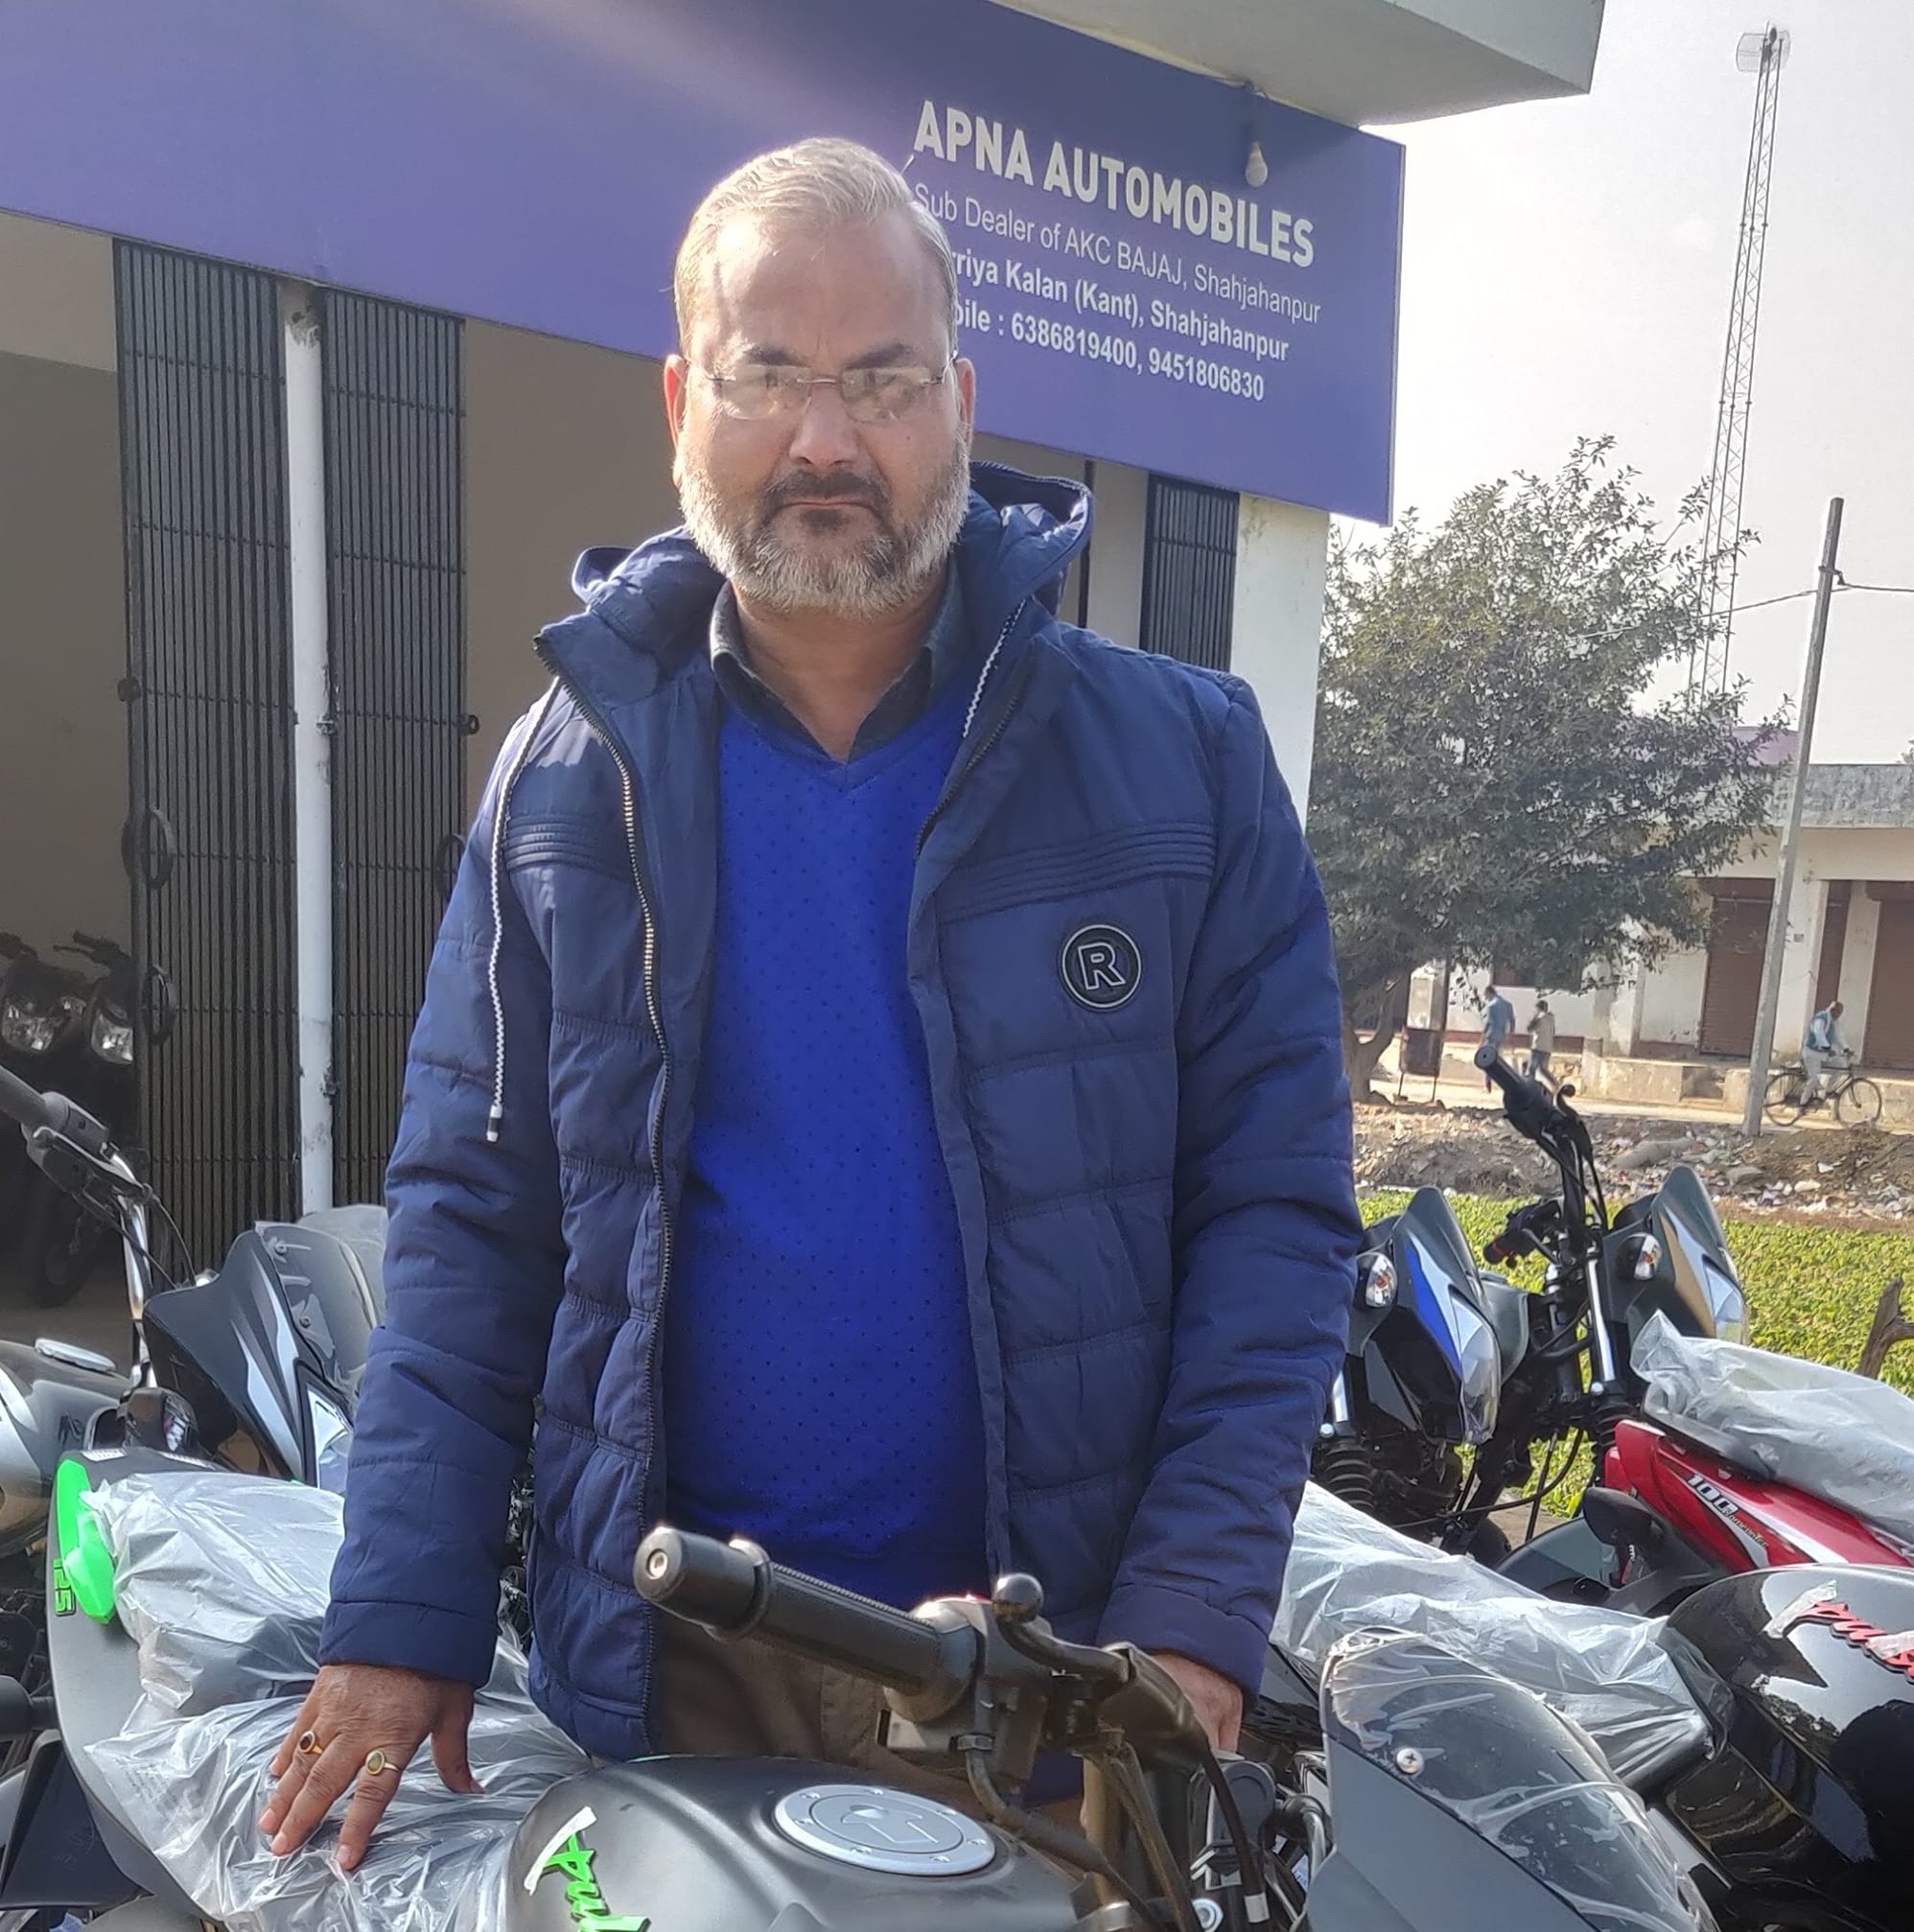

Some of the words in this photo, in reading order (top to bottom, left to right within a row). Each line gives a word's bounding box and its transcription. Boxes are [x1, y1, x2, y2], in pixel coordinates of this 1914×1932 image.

[913, 100, 1034, 186] APNA
[1043, 141, 1314, 268] AUTOMOBILES
[915, 183, 958, 221] Sub
[966, 197, 1035, 243] Dealer
[1040, 223, 1062, 251] of
[1064, 227, 1110, 265] AKC
[1117, 242, 1187, 291] BAJAJ,
[1195, 264, 1320, 324] Shahjahanpur
[1007, 259, 1067, 303] Kalan
[1075, 279, 1144, 328] (Kant),
[1151, 299, 1289, 361] Shahjahanpur
[1012, 313, 1142, 375] 6386819400,
[1149, 347, 1264, 401] 9451806830
[1078, 943, 1127, 990] R
[1687, 1474, 1739, 1517] 100
